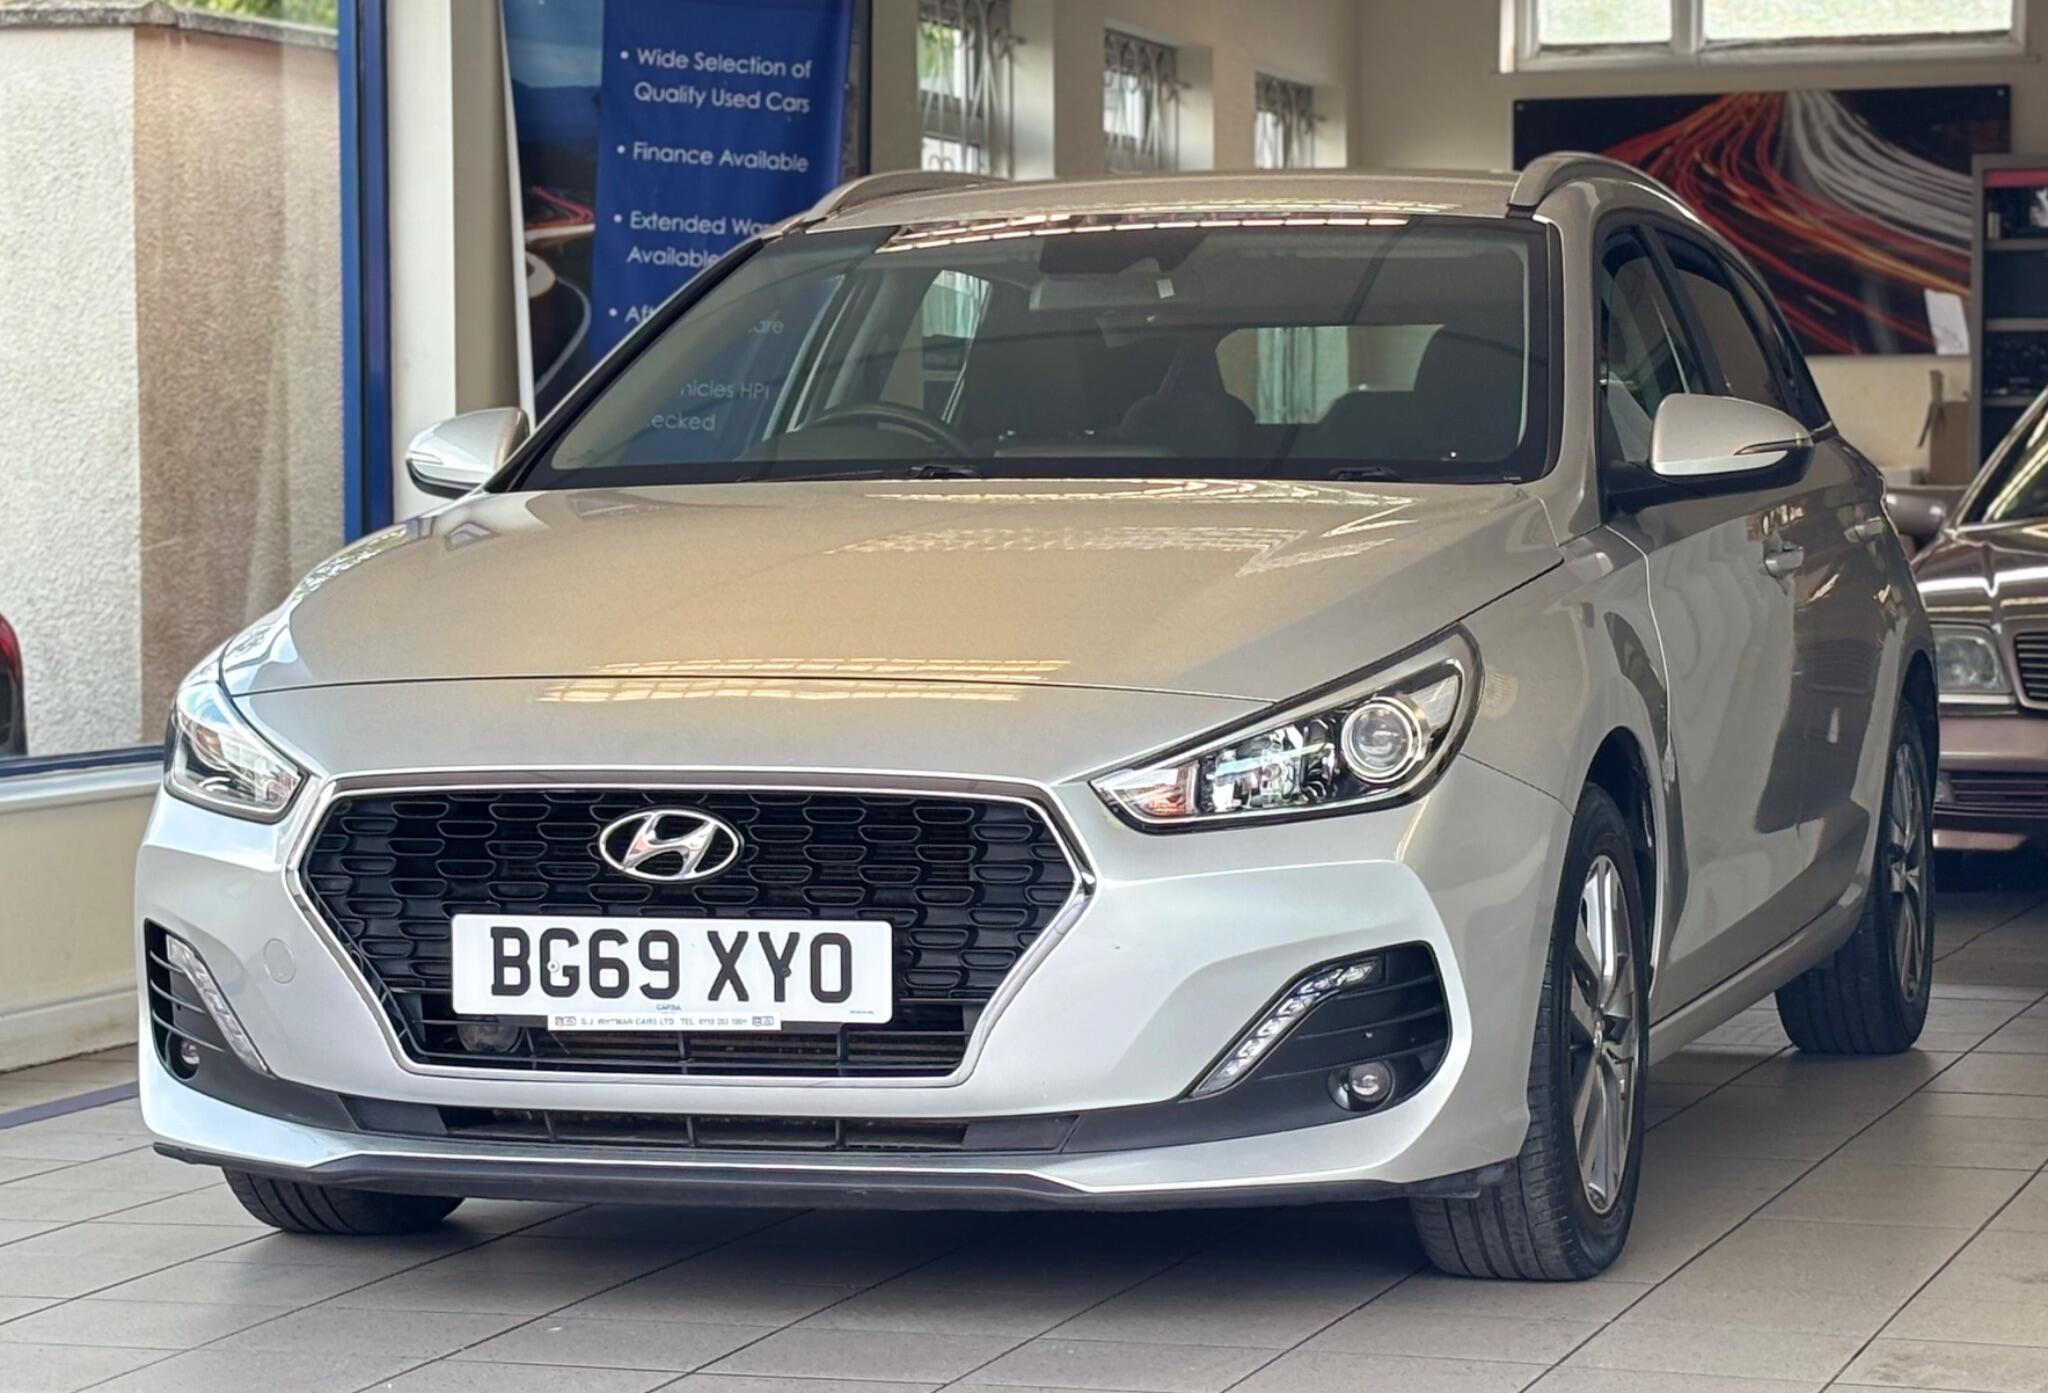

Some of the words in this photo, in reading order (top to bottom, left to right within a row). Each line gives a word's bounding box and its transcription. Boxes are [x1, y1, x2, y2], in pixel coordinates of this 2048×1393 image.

[637, 47, 689, 70] Wide
[694, 51, 784, 76] Selection
[790, 59, 813, 79] of
[633, 81, 707, 107] Quality
[711, 88, 761, 109] Used
[765, 93, 811, 114] Cars
[632, 141, 713, 166] Finance
[718, 147, 810, 173] Available
[629, 210, 726, 236] Extended
[650, 413, 716, 431] ecked
[490, 926, 680, 1000] BG69
